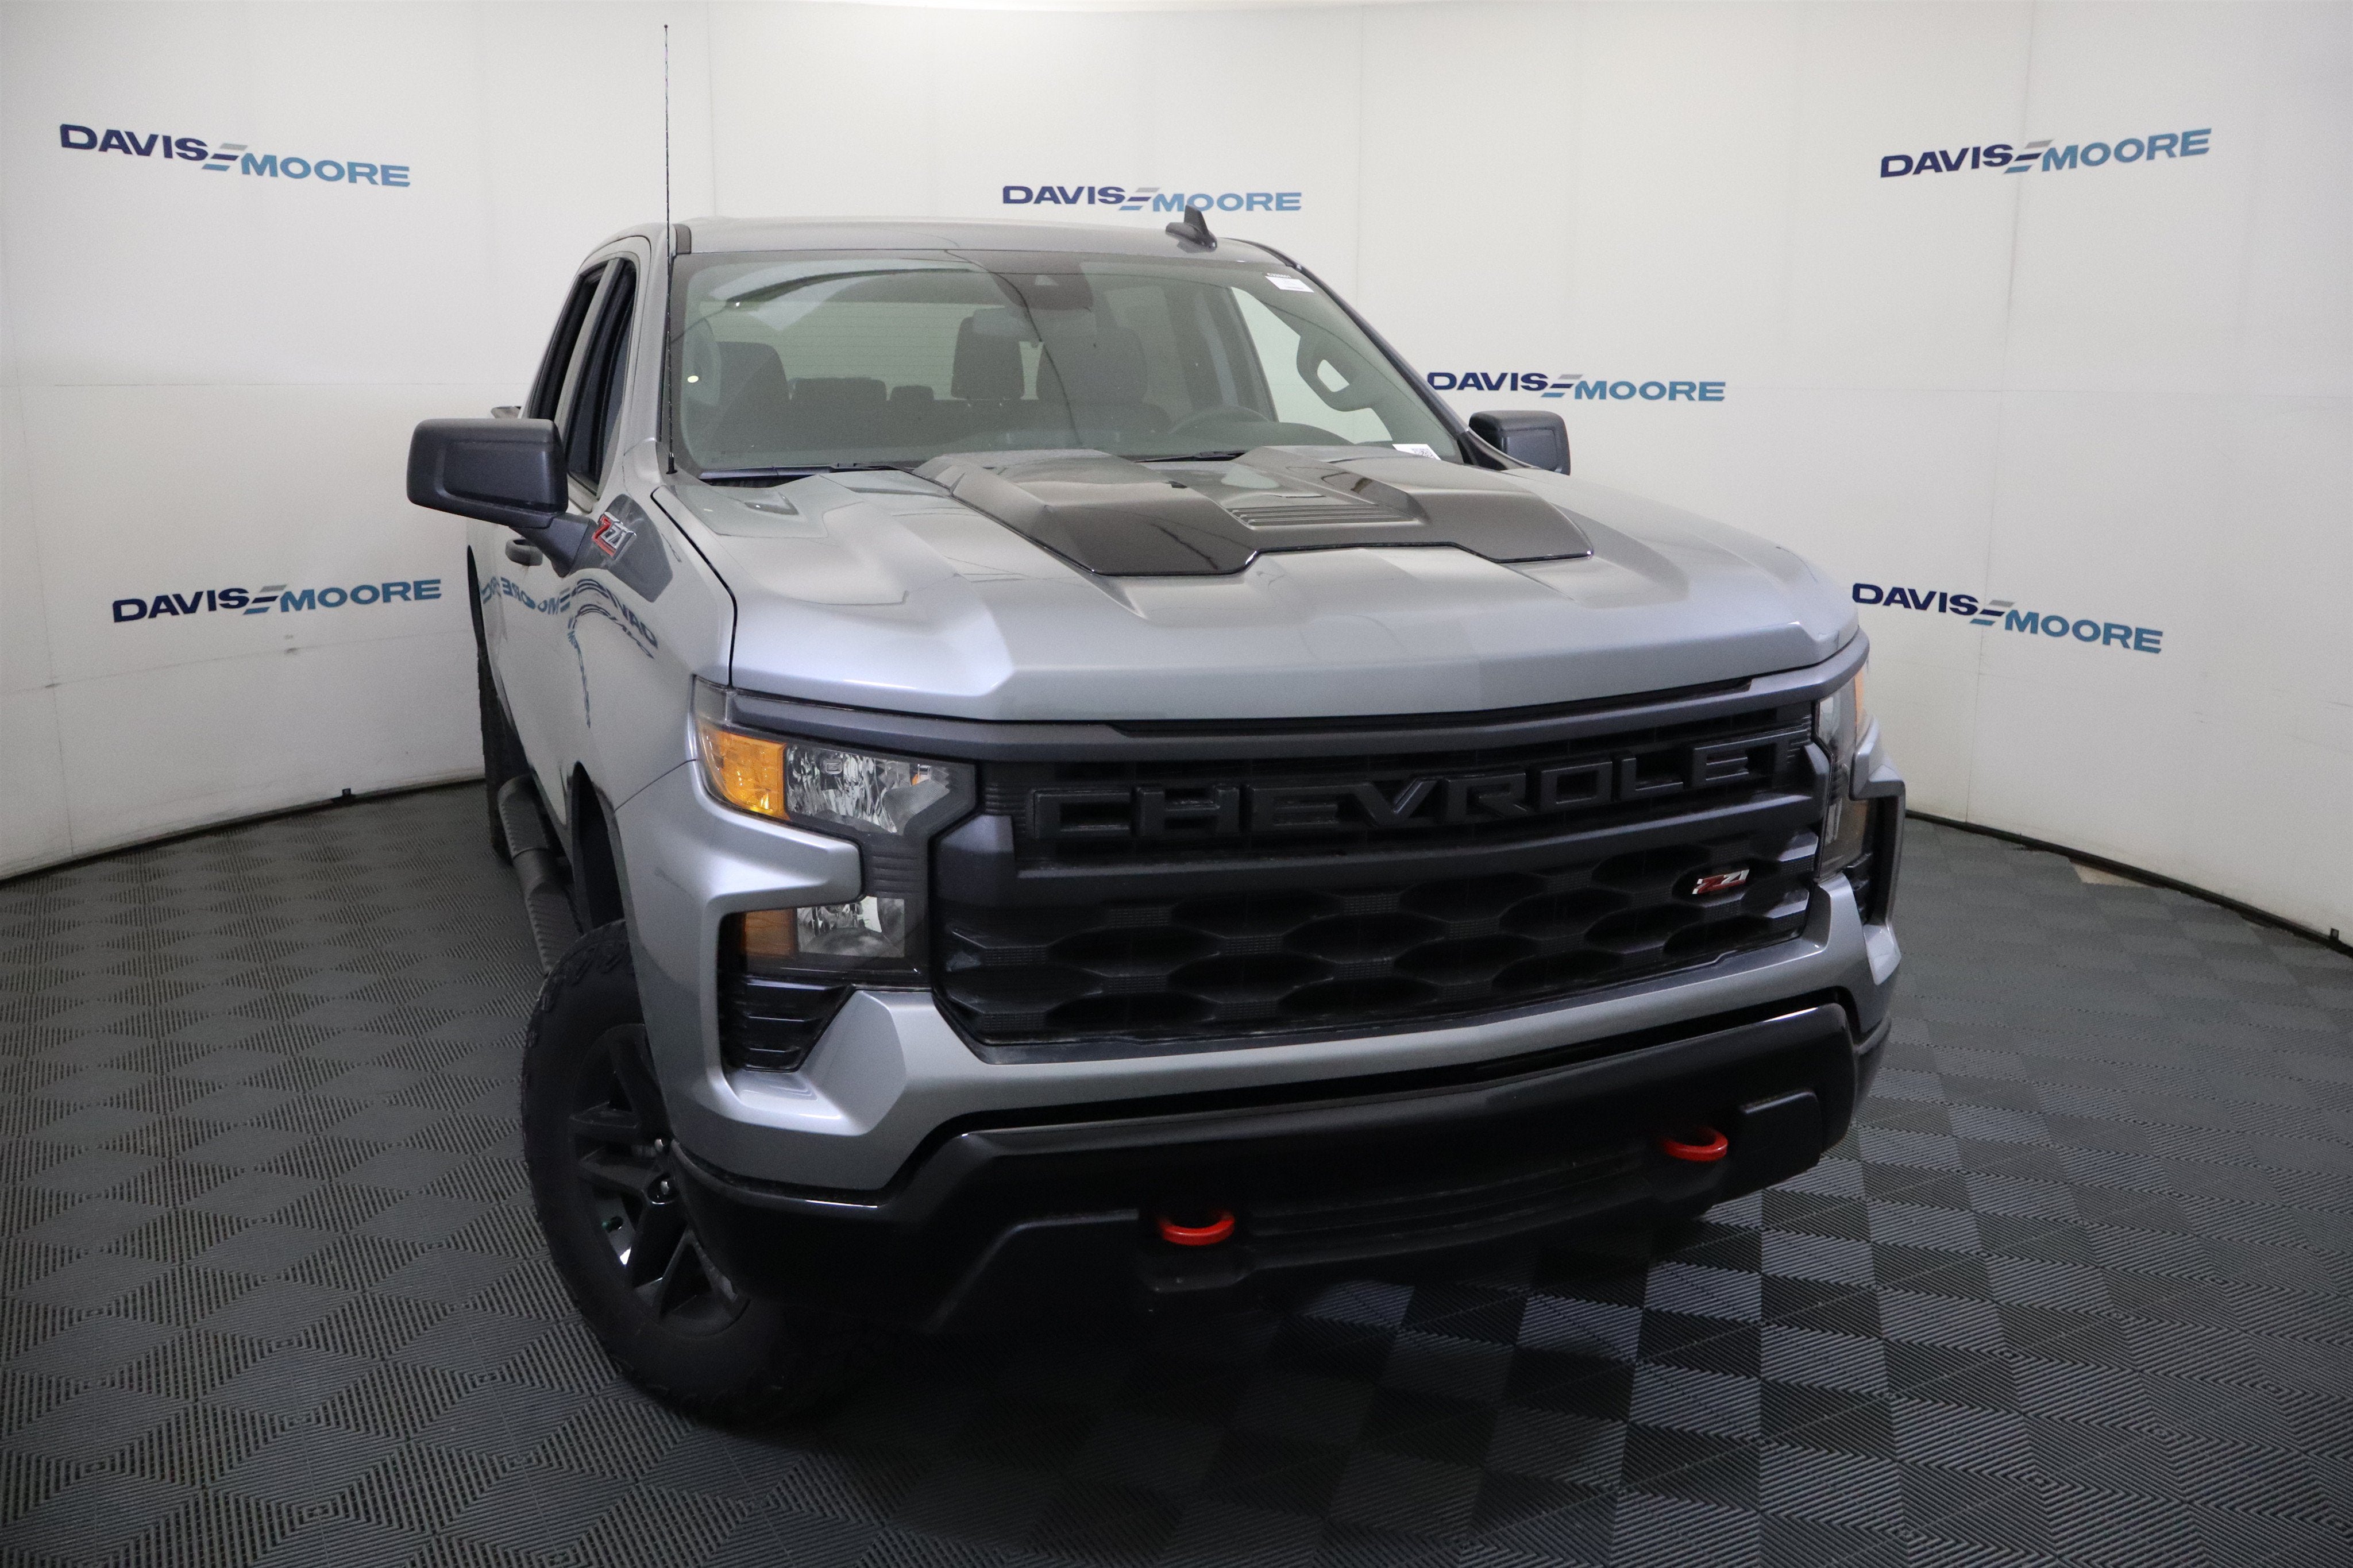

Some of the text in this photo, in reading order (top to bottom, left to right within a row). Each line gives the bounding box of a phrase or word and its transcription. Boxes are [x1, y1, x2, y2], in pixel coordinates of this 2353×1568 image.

[59, 123, 410, 187] DAVIS MOORE
[1880, 128, 2211, 178] DAVIS MOORE
[1002, 186, 1302, 212] DAVIS MOORE
[1427, 372, 1726, 401] DAVIS MOORE
[112, 588, 250, 623] DAVIS
[280, 578, 442, 613] MOORE
[1851, 582, 2163, 654] DAVIS MOORE
[1692, 868, 1750, 895] Z71
